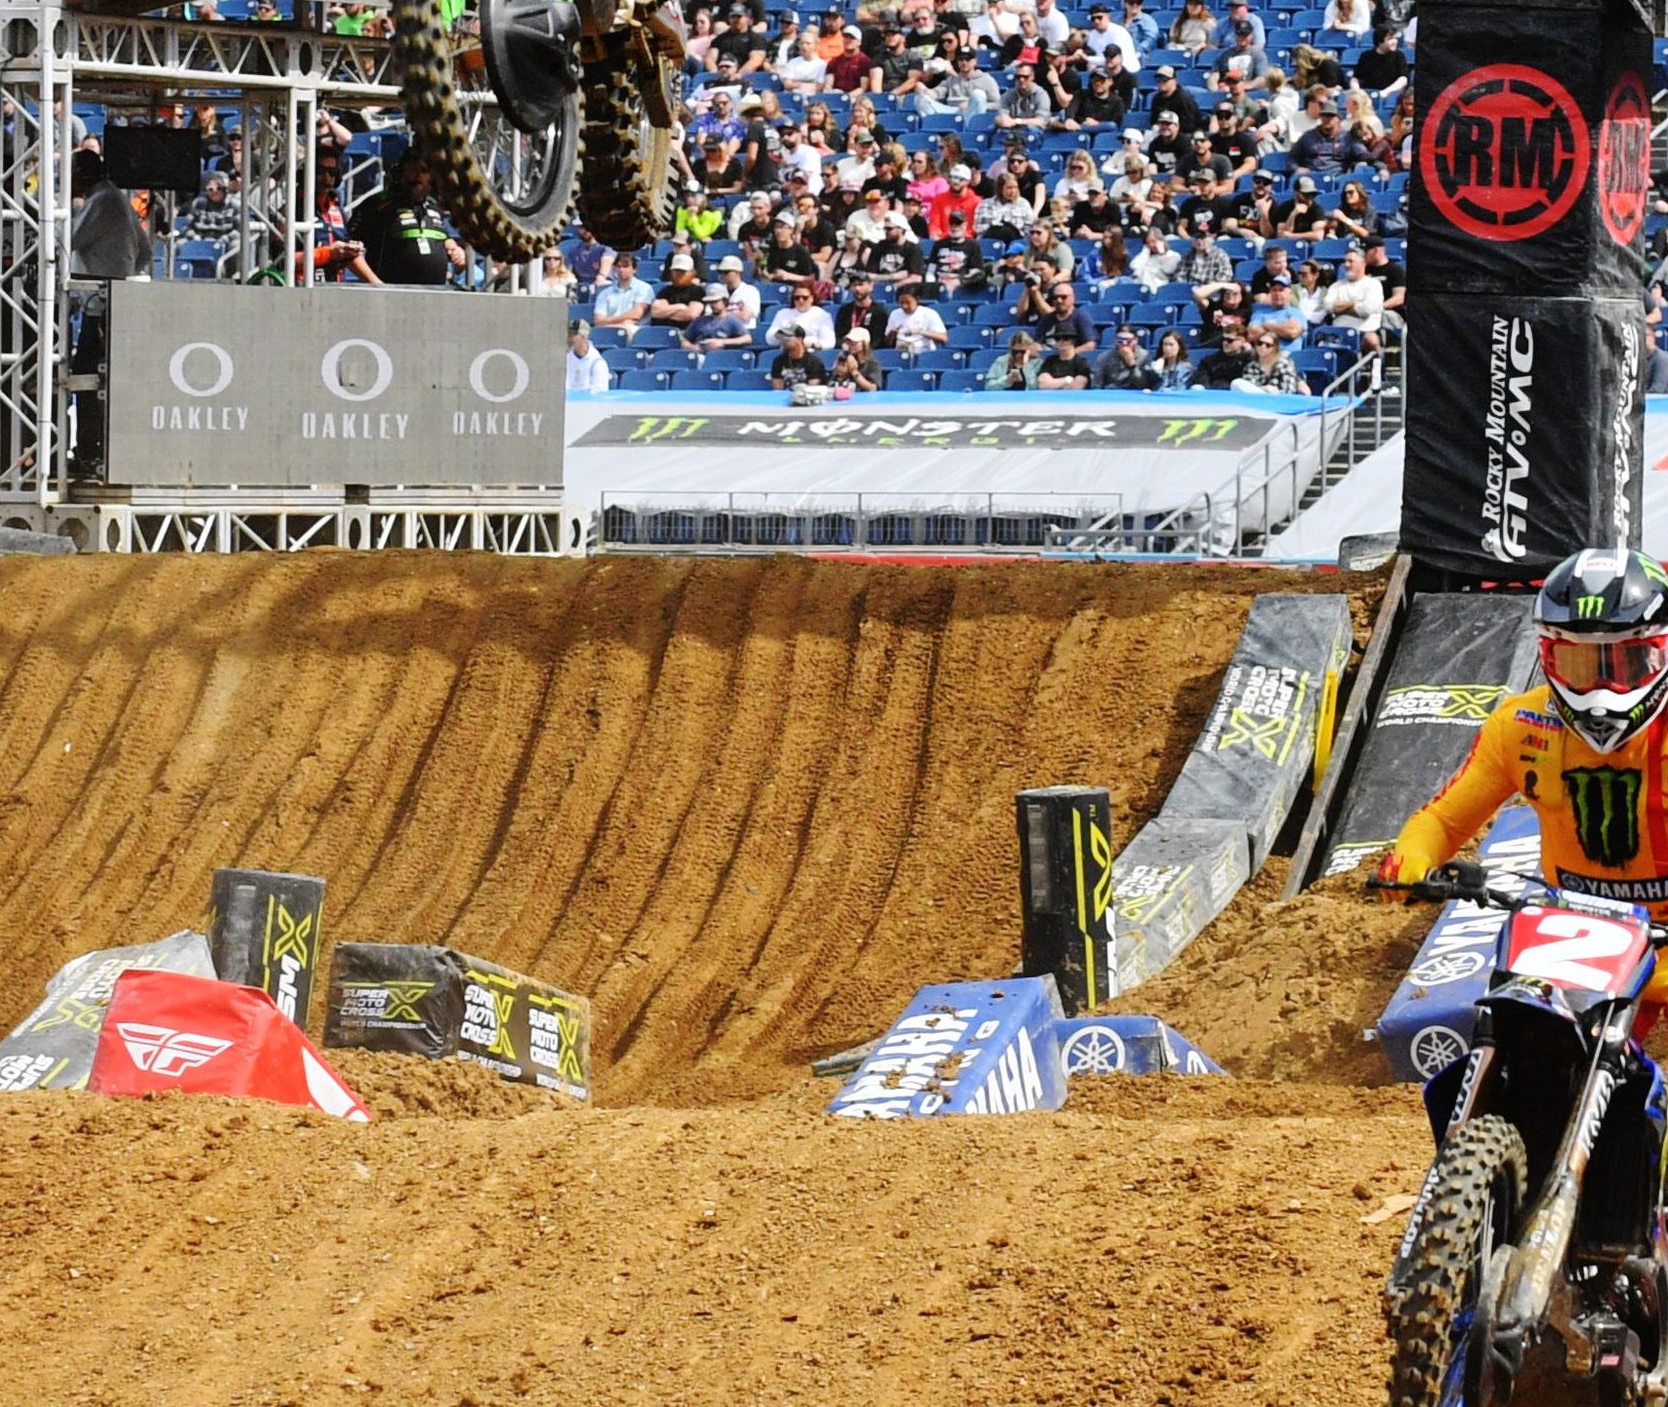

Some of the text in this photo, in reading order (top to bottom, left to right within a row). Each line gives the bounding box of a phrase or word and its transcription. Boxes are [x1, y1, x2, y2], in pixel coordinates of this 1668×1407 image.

[1453, 117, 1562, 189] RM
[152, 405, 249, 432] OAKLEY
[302, 412, 409, 441] OAKLEY
[453, 411, 544, 437] OAKLEY
[1482, 315, 1509, 523] ROCKY MOUNTAIN
[1506, 913, 1634, 992] 2
[342, 989, 388, 1000] SUPER
[344, 998, 386, 1008] MOTO
[339, 1006, 386, 1017] CROSS
